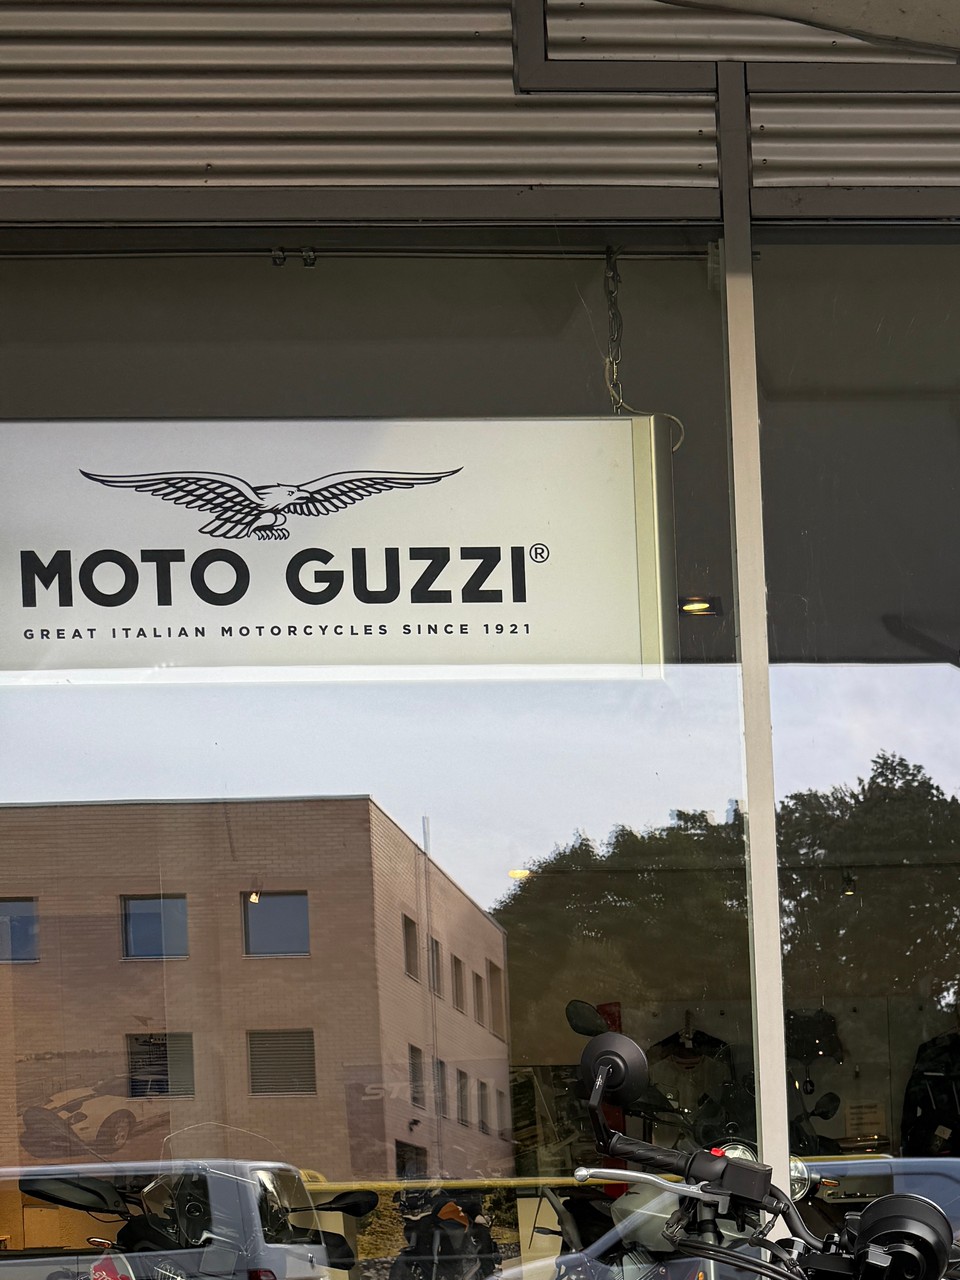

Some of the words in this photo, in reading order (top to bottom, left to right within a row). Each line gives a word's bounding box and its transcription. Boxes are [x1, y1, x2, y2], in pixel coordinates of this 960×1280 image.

[20, 547, 251, 608] MOTO
[23, 627, 97, 640] GREAT
[111, 626, 207, 639] ITALIAN
[220, 624, 389, 638] MOTORCYCLES
[402, 623, 469, 636] SINCE
[483, 623, 532, 635] 1921
